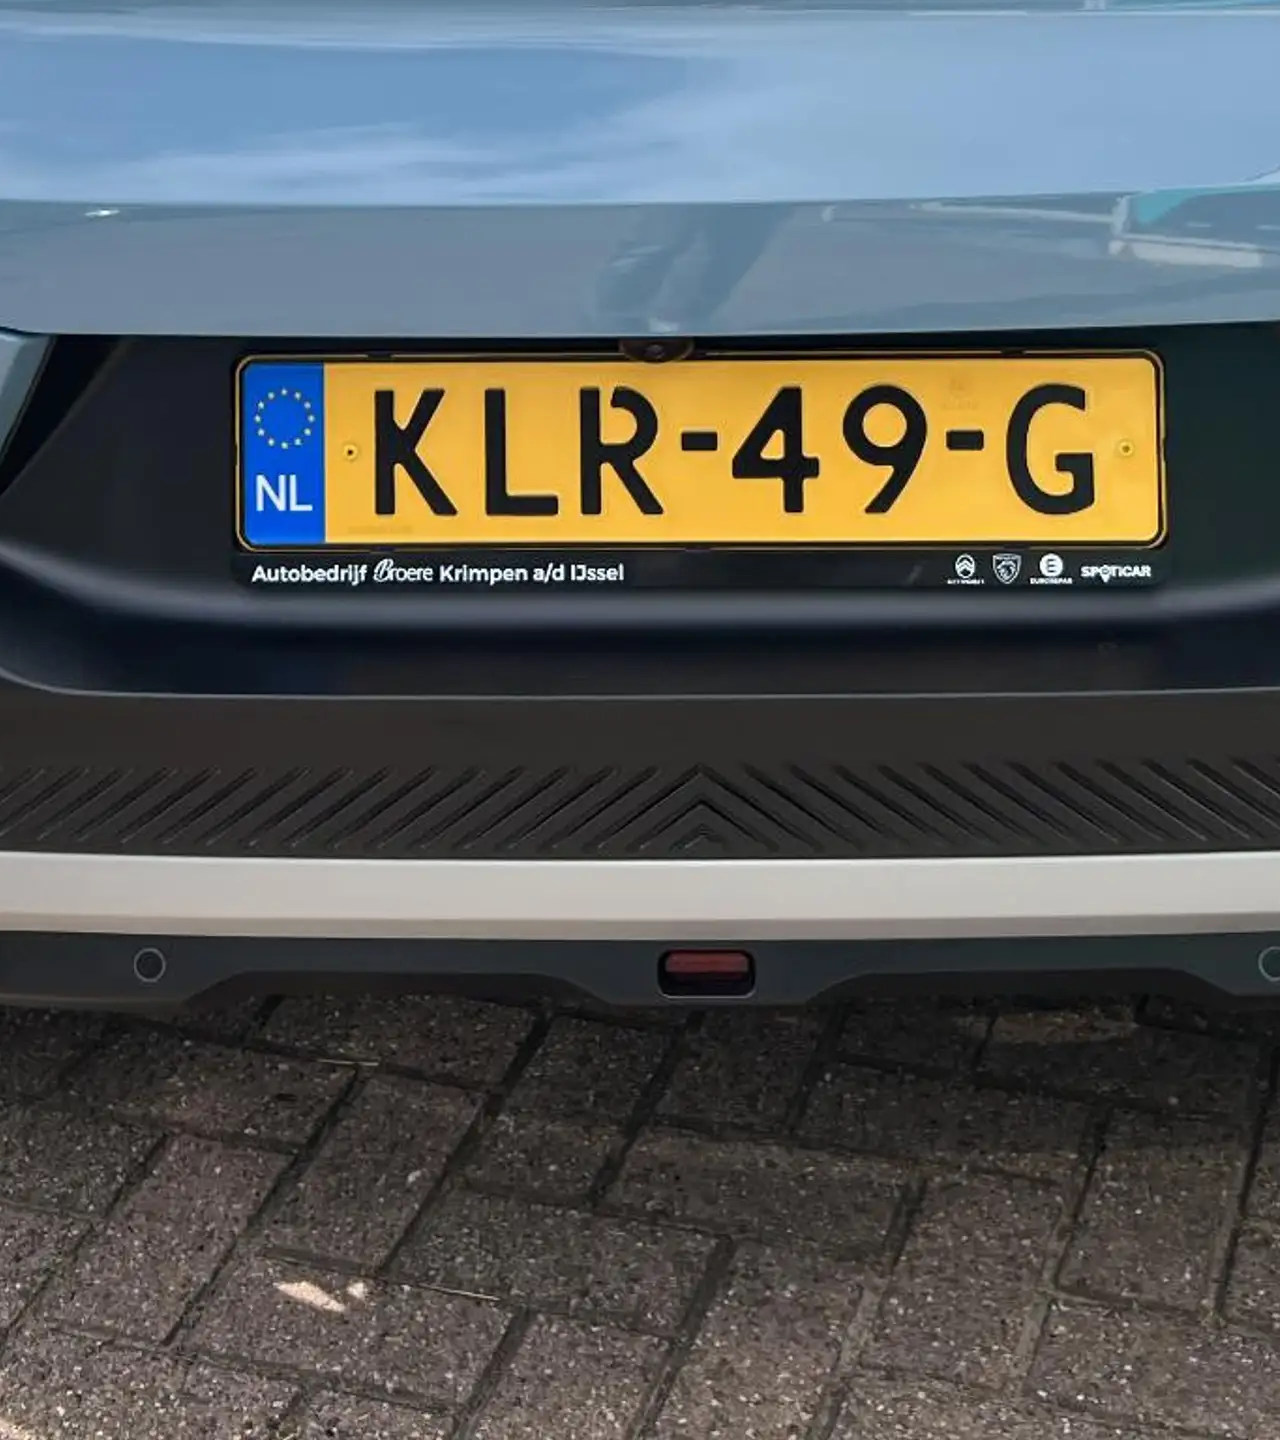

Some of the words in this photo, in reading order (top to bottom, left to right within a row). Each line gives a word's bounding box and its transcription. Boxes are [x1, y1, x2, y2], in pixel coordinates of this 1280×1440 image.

[255, 473, 313, 514] NL
[373, 383, 1099, 517] KLR-49-G
[251, 563, 368, 587] Autobedrijf
[372, 558, 434, 583] Broere
[439, 563, 528, 587] Krimpen
[532, 564, 565, 583] a/d
